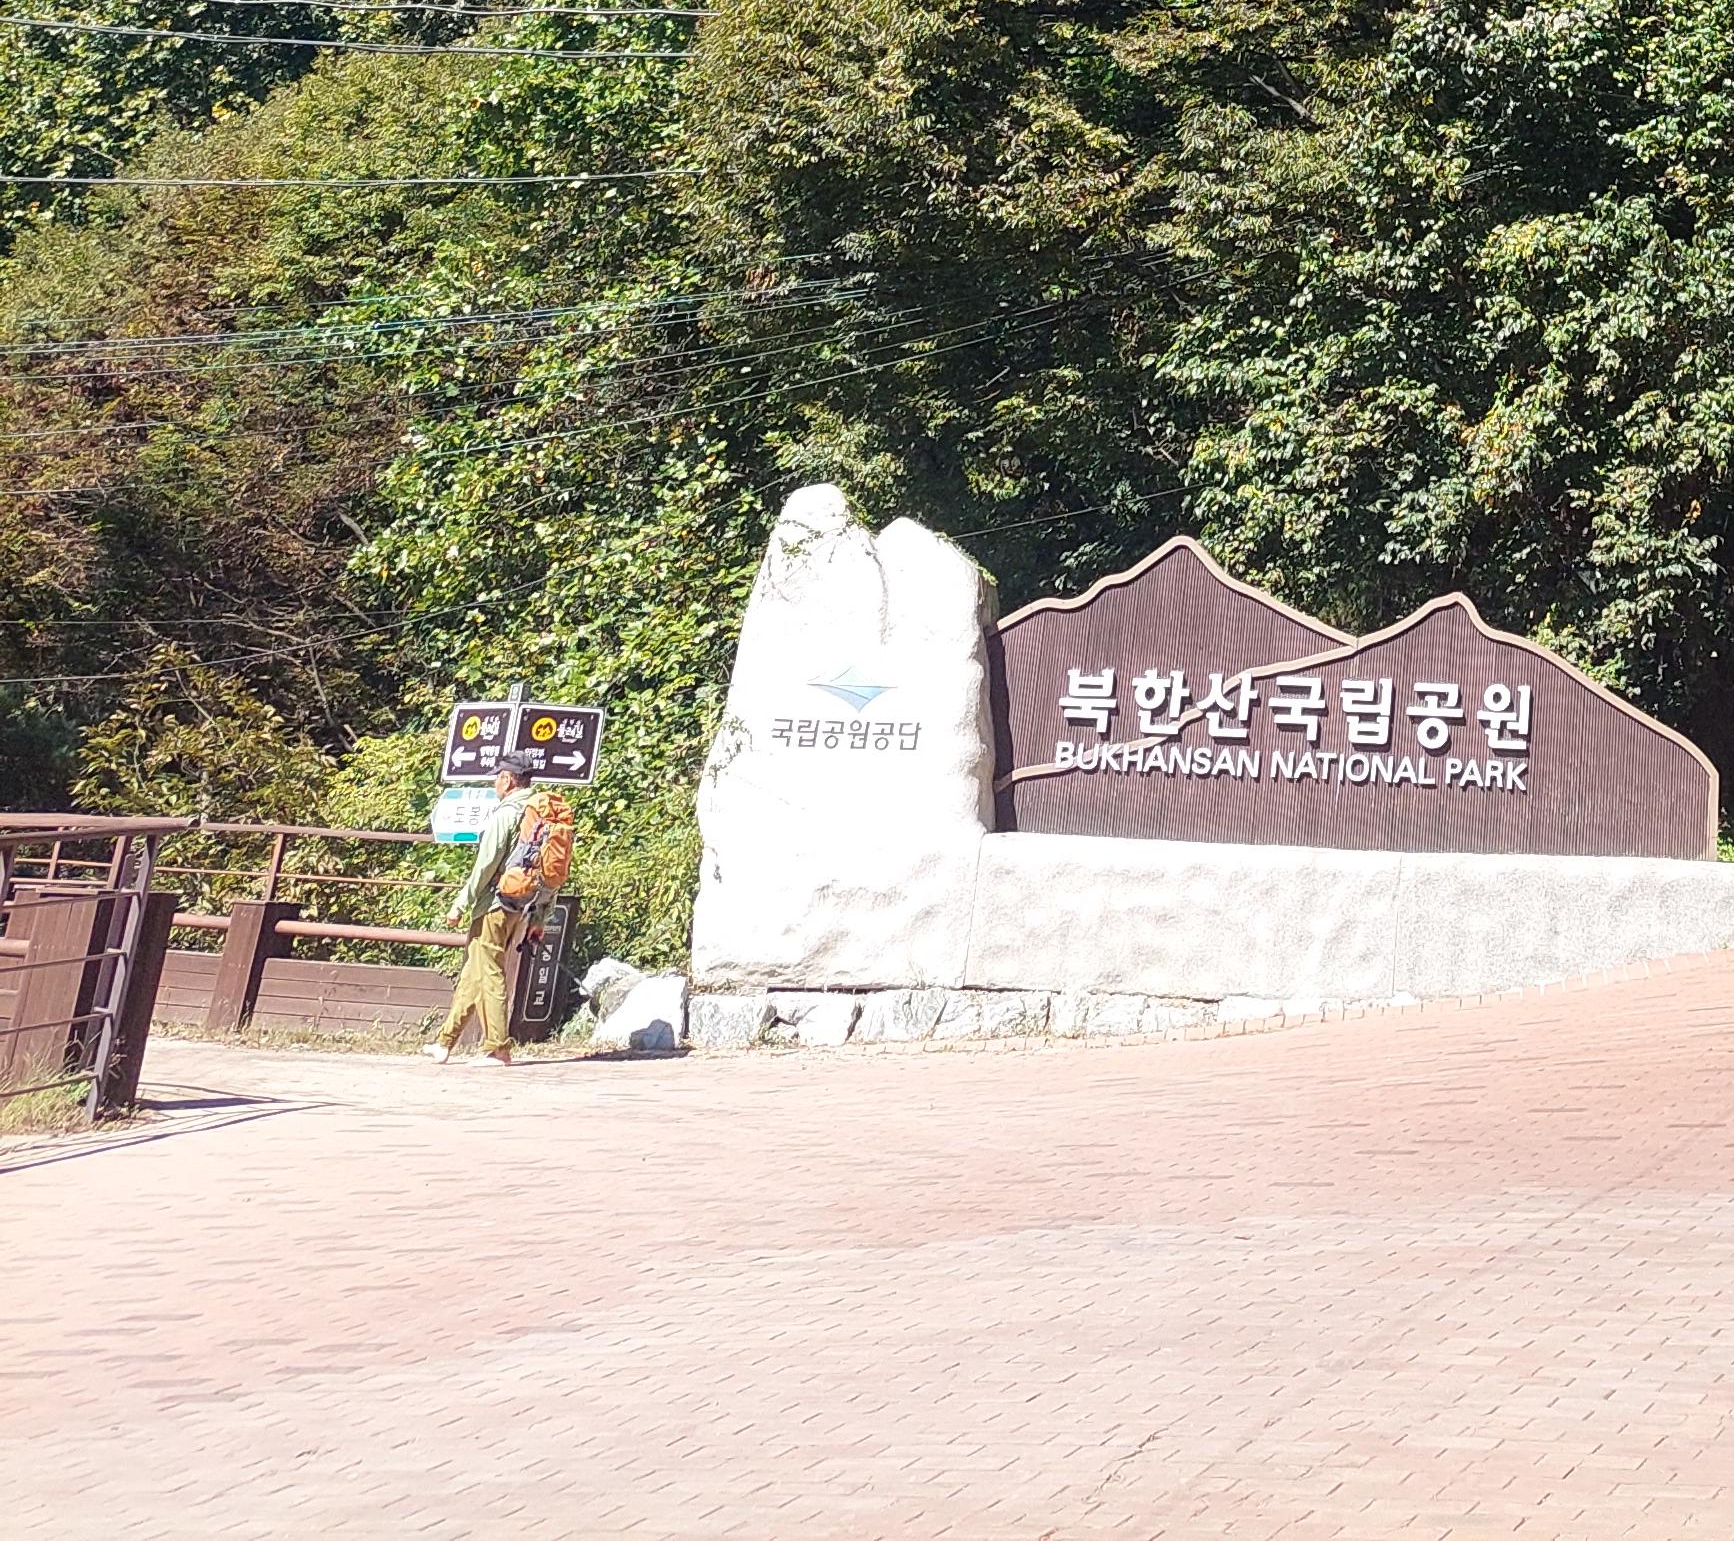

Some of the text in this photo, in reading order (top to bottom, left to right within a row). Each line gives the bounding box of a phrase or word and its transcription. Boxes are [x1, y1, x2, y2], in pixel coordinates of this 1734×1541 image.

[1058, 667, 1531, 750] 북한산국립공원
[771, 718, 922, 751] 국립공원공단
[1055, 741, 1528, 791] BUKHANSAN NATIONAL PARK
